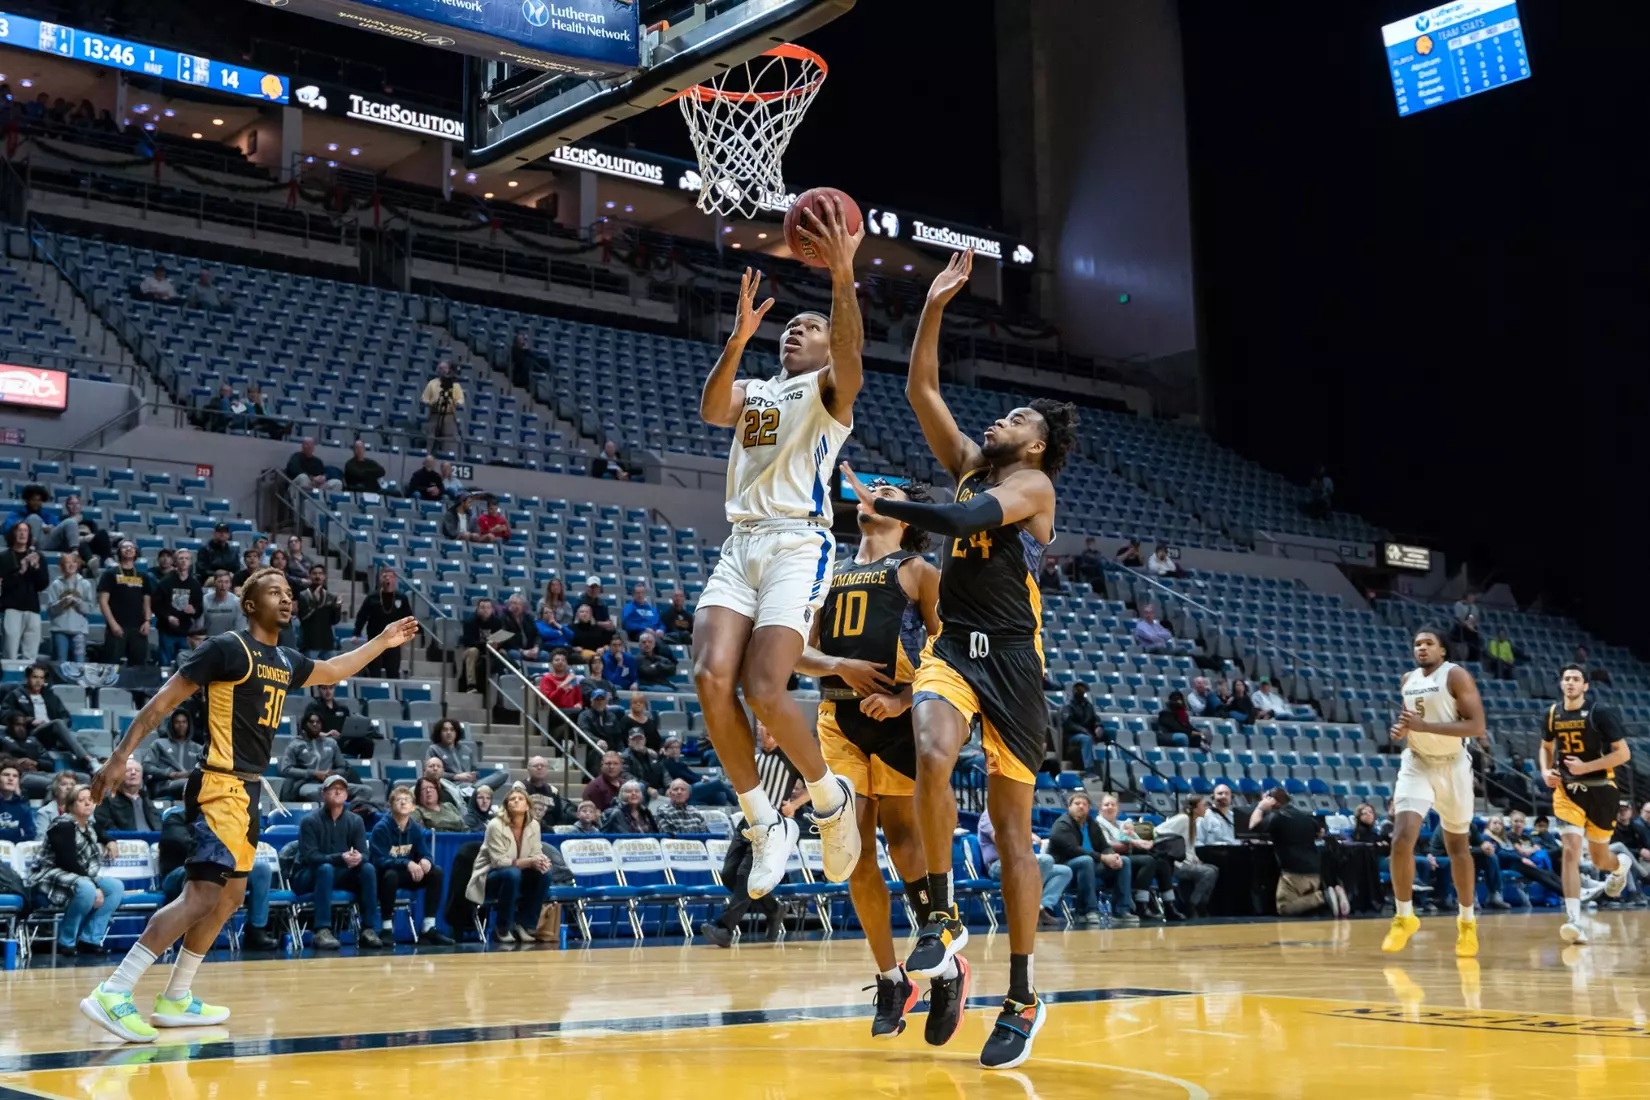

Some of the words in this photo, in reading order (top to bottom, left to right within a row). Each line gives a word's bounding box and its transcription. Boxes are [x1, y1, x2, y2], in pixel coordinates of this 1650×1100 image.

[551, 4, 605, 24] Lutheran
[552, 19, 585, 34] Health
[587, 25, 630, 41] Network
[83, 37, 135, 67] 13:46
[149, 48, 155, 61] 1
[183, 57, 190, 68] 3
[182, 70, 190, 80] 4
[221, 68, 239, 89] 14
[349, 94, 464, 137] TECHSOLUTION
[743, 408, 780, 448] 22
[452, 465, 470, 479] 215
[831, 570, 888, 588] OMMERCE
[833, 590, 868, 638] 10
[258, 685, 286, 729] 30
[1415, 697, 1425, 719] 5
[1558, 732, 1585, 753] 35
